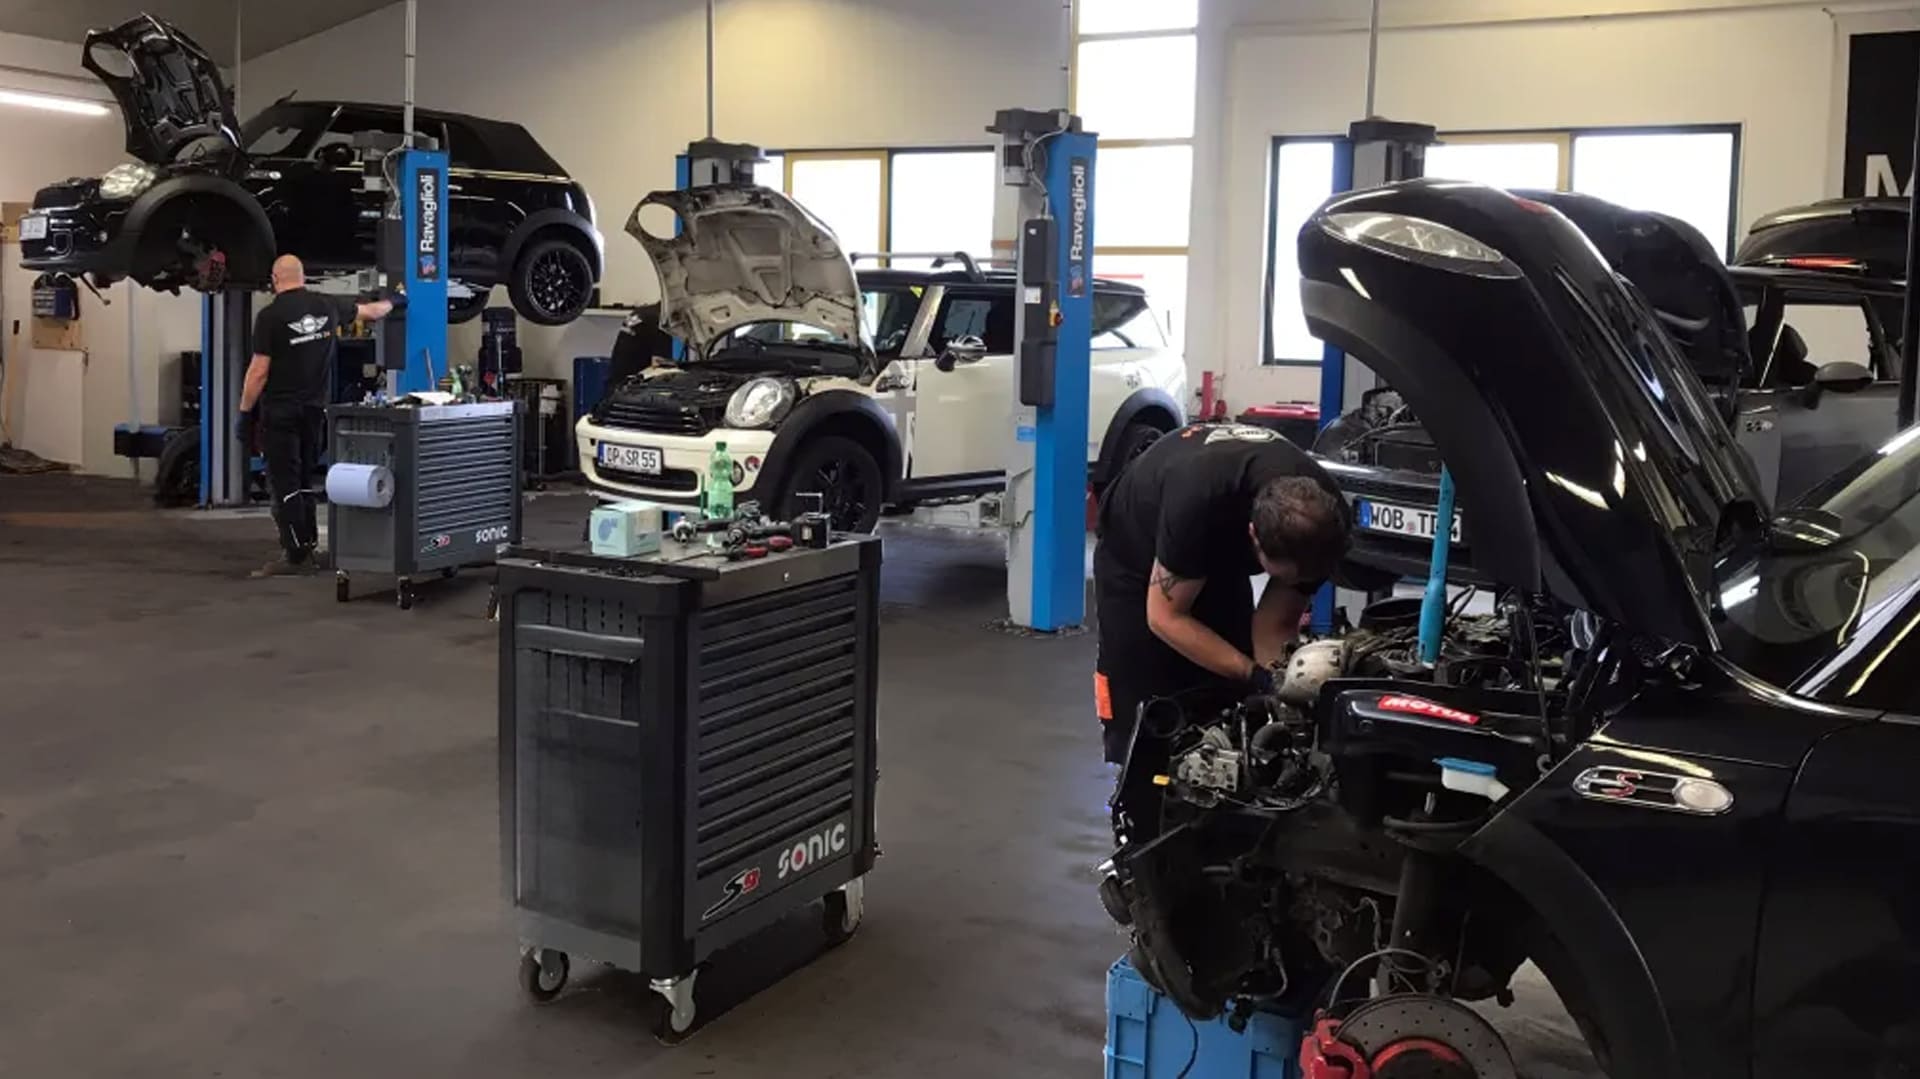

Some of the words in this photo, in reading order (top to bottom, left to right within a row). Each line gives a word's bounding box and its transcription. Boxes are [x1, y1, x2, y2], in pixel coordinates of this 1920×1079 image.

[420, 174, 437, 252] Ravaglioli
[1070, 165, 1086, 260] Ravaglioli
[641, 451, 657, 469] 55
[1370, 505, 1404, 530] WOB
[1384, 697, 1472, 723] MOTUL
